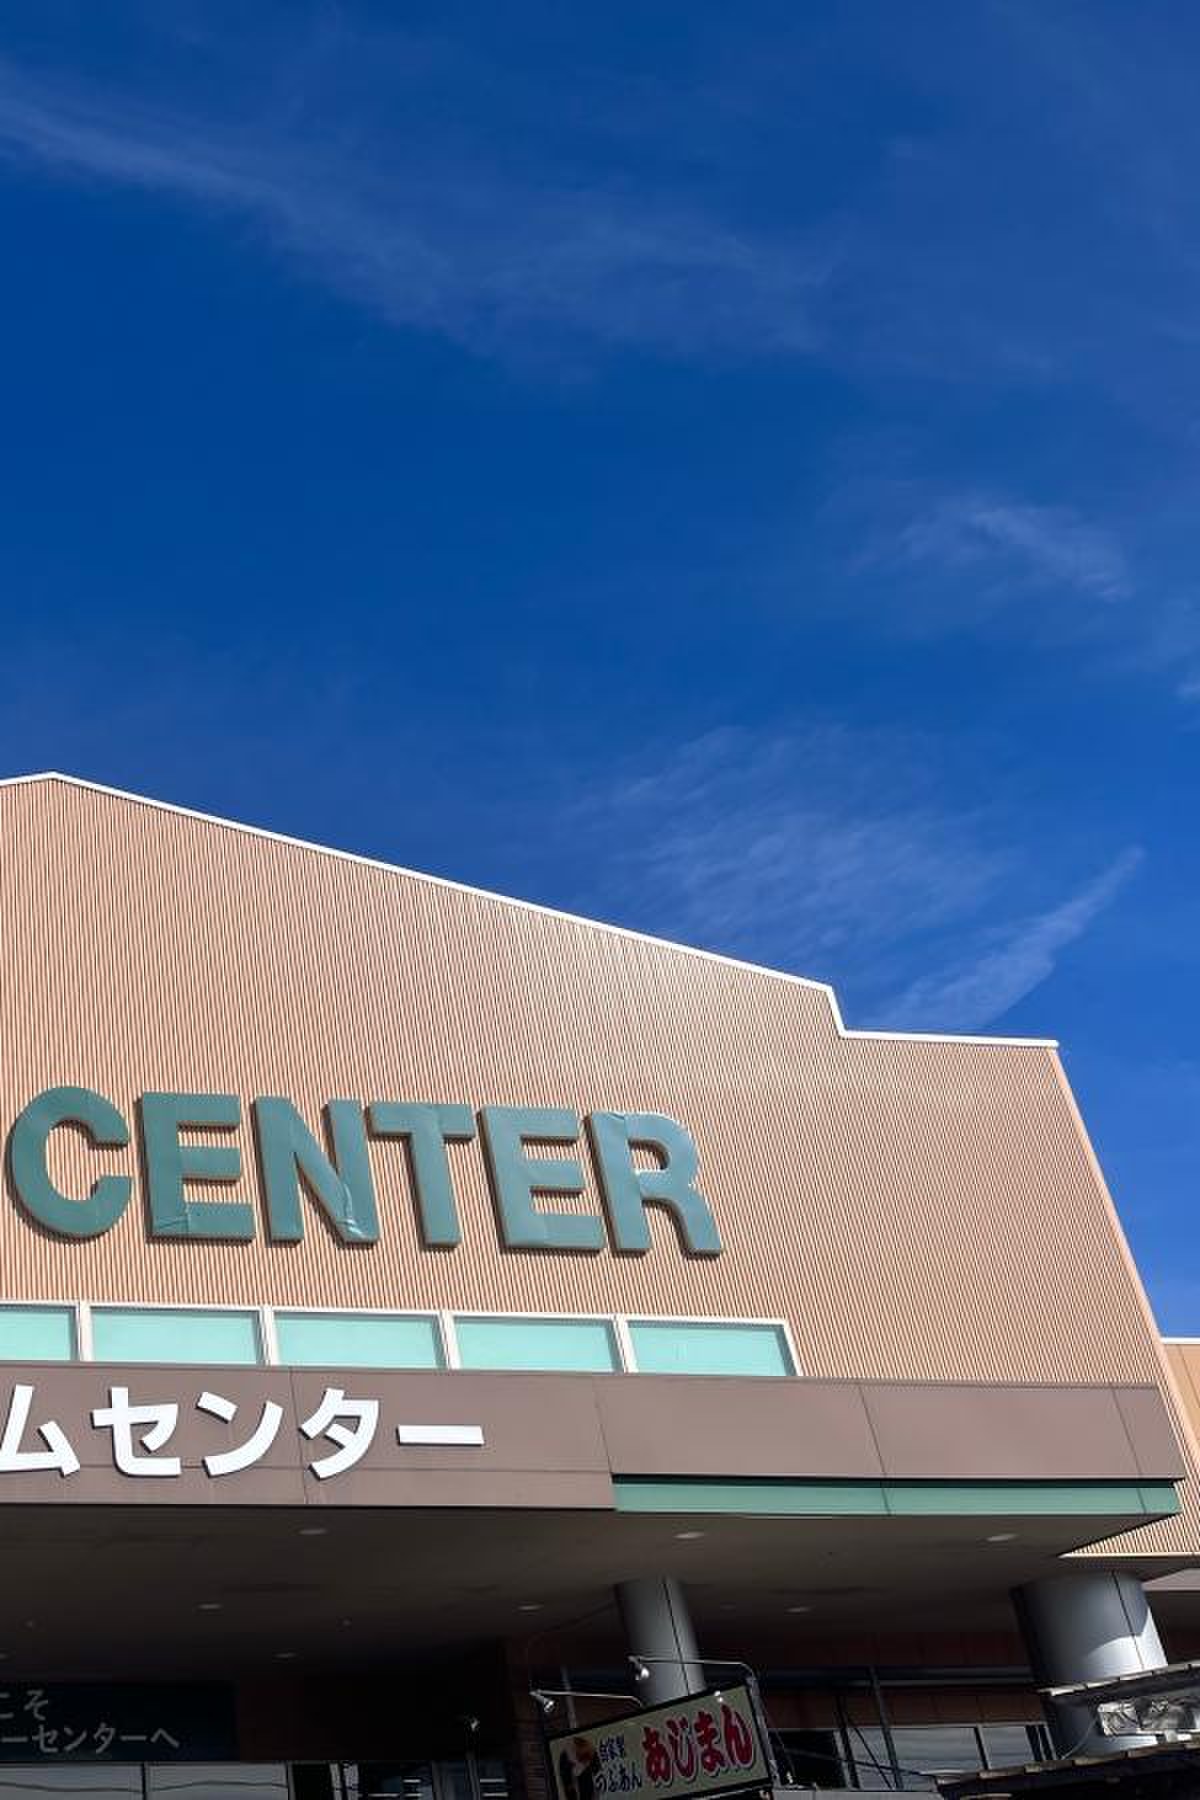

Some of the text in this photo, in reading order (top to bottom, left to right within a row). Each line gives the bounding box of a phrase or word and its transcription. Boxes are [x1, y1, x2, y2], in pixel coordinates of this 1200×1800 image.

[4, 1085, 722, 1257] CENTER
[642, 1704, 753, 1787] あじまん
